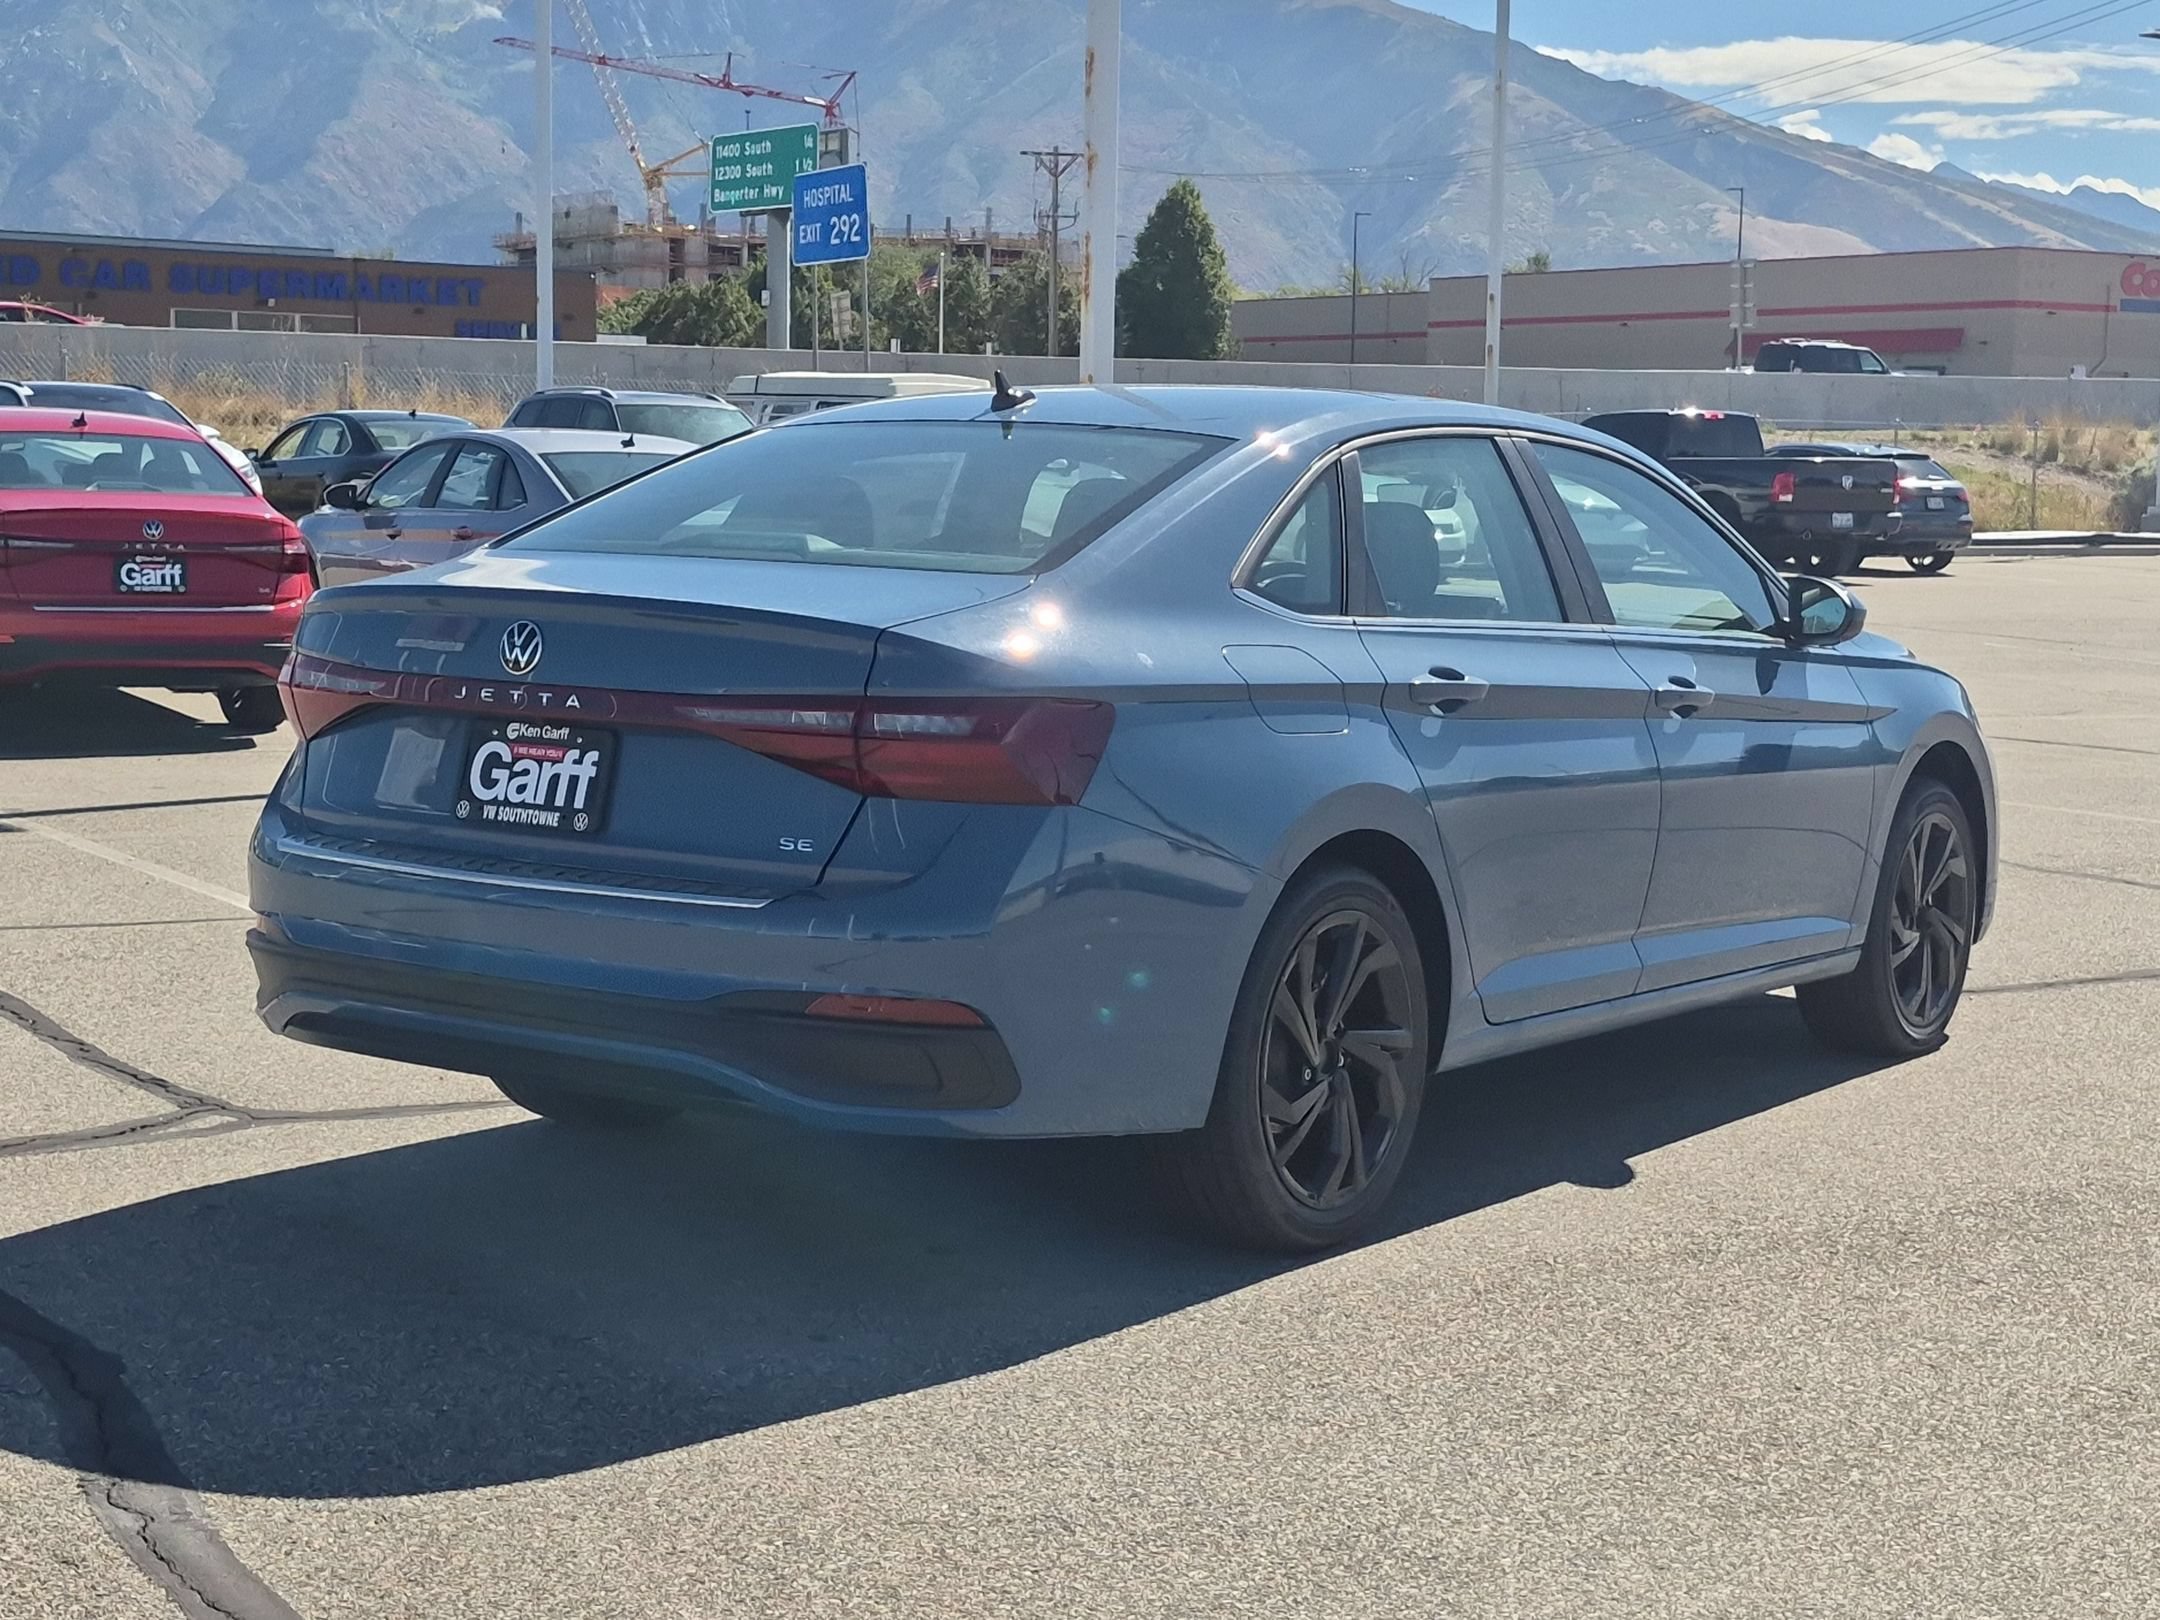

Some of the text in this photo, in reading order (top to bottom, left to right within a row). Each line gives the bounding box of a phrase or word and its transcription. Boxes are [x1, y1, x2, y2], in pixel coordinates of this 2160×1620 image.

[715, 142, 741, 160] 11400
[744, 139, 772, 156] South
[715, 164, 742, 181] 12300
[745, 161, 773, 178] South
[714, 183, 784, 205] Bangerter Hwy
[803, 183, 853, 209] HOSPITAL
[799, 213, 861, 245] EXIT 292
[60, 258, 151, 290] CAR
[169, 263, 485, 306] SUPERMARKET
[120, 562, 182, 586] Garff
[454, 685, 581, 709] JETTA
[519, 723, 570, 740] Ken Garff
[470, 741, 599, 809] Garff
[483, 804, 561, 827] VW SOUTHTOWNE
[779, 837, 814, 851] SE
